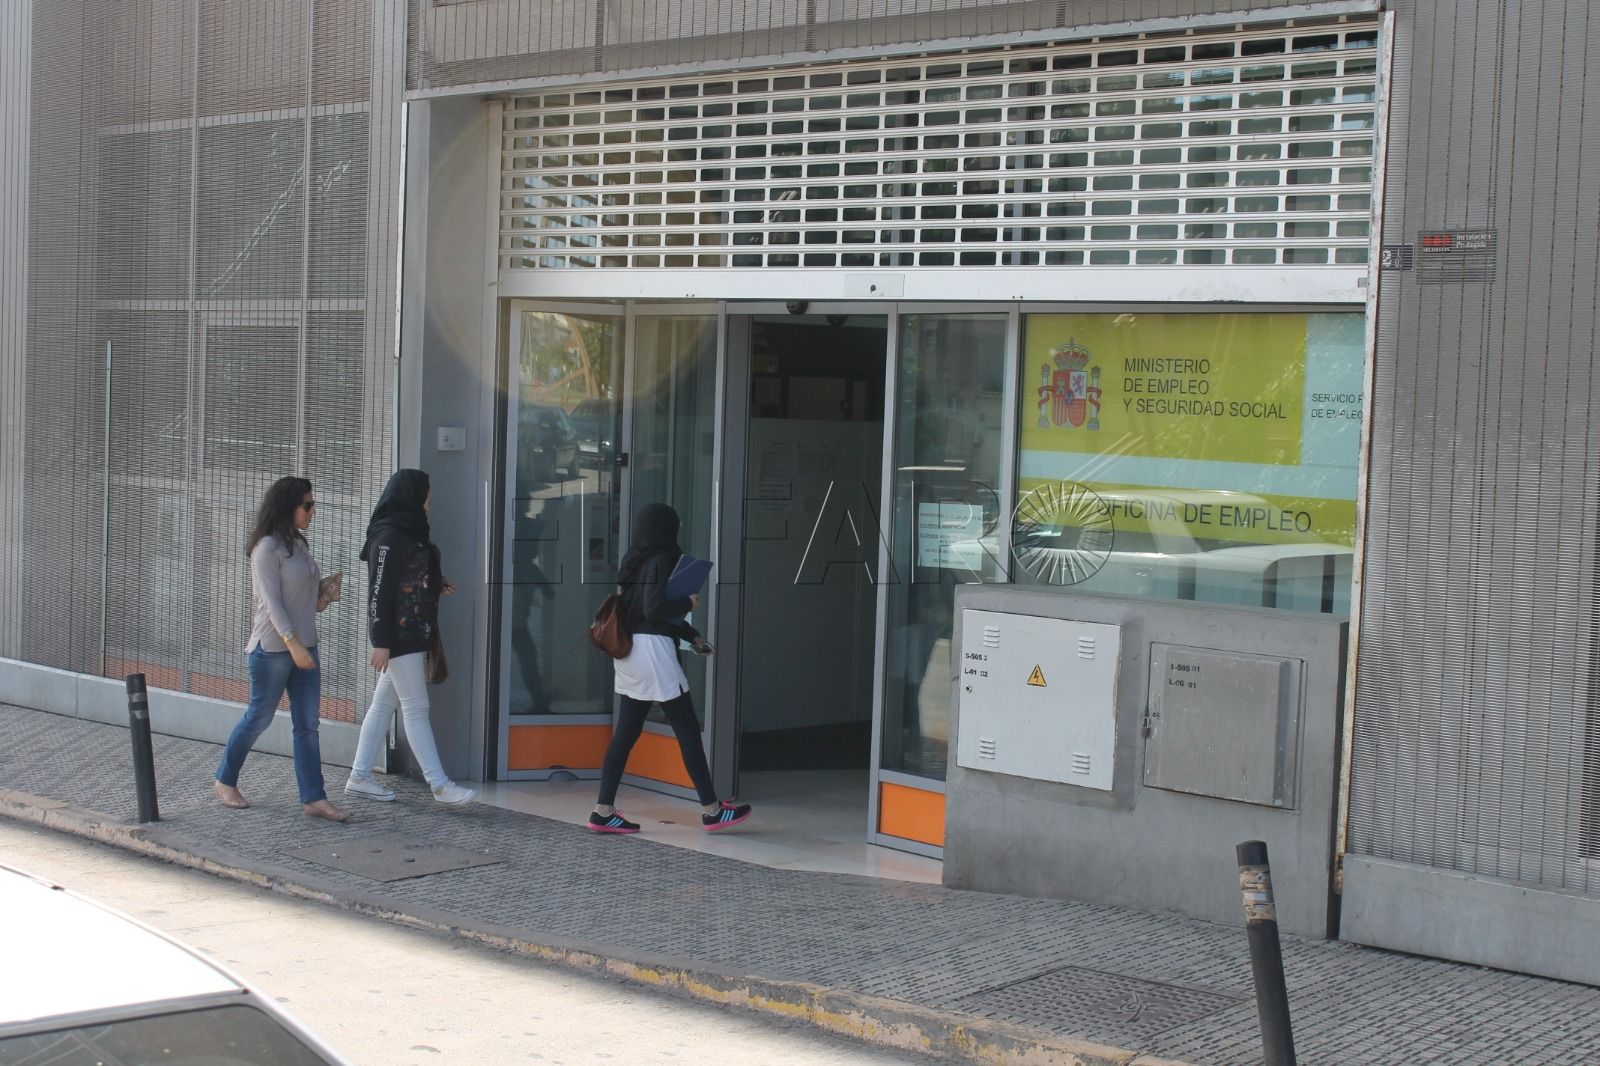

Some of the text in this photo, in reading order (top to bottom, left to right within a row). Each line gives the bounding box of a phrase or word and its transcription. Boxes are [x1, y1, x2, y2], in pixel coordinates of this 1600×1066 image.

[1124, 358, 1210, 374] MINISTERIO
[1123, 377, 1210, 395] DE EMPLEO
[1311, 393, 1356, 404] SERVICIO
[1123, 398, 1287, 419] Y SEGURIDAD SOCIAL
[1311, 408, 1324, 418] DE
[1096, 497, 1312, 533] OFICINA DE EMPLEO
[373, 549, 387, 595] ANGELES
